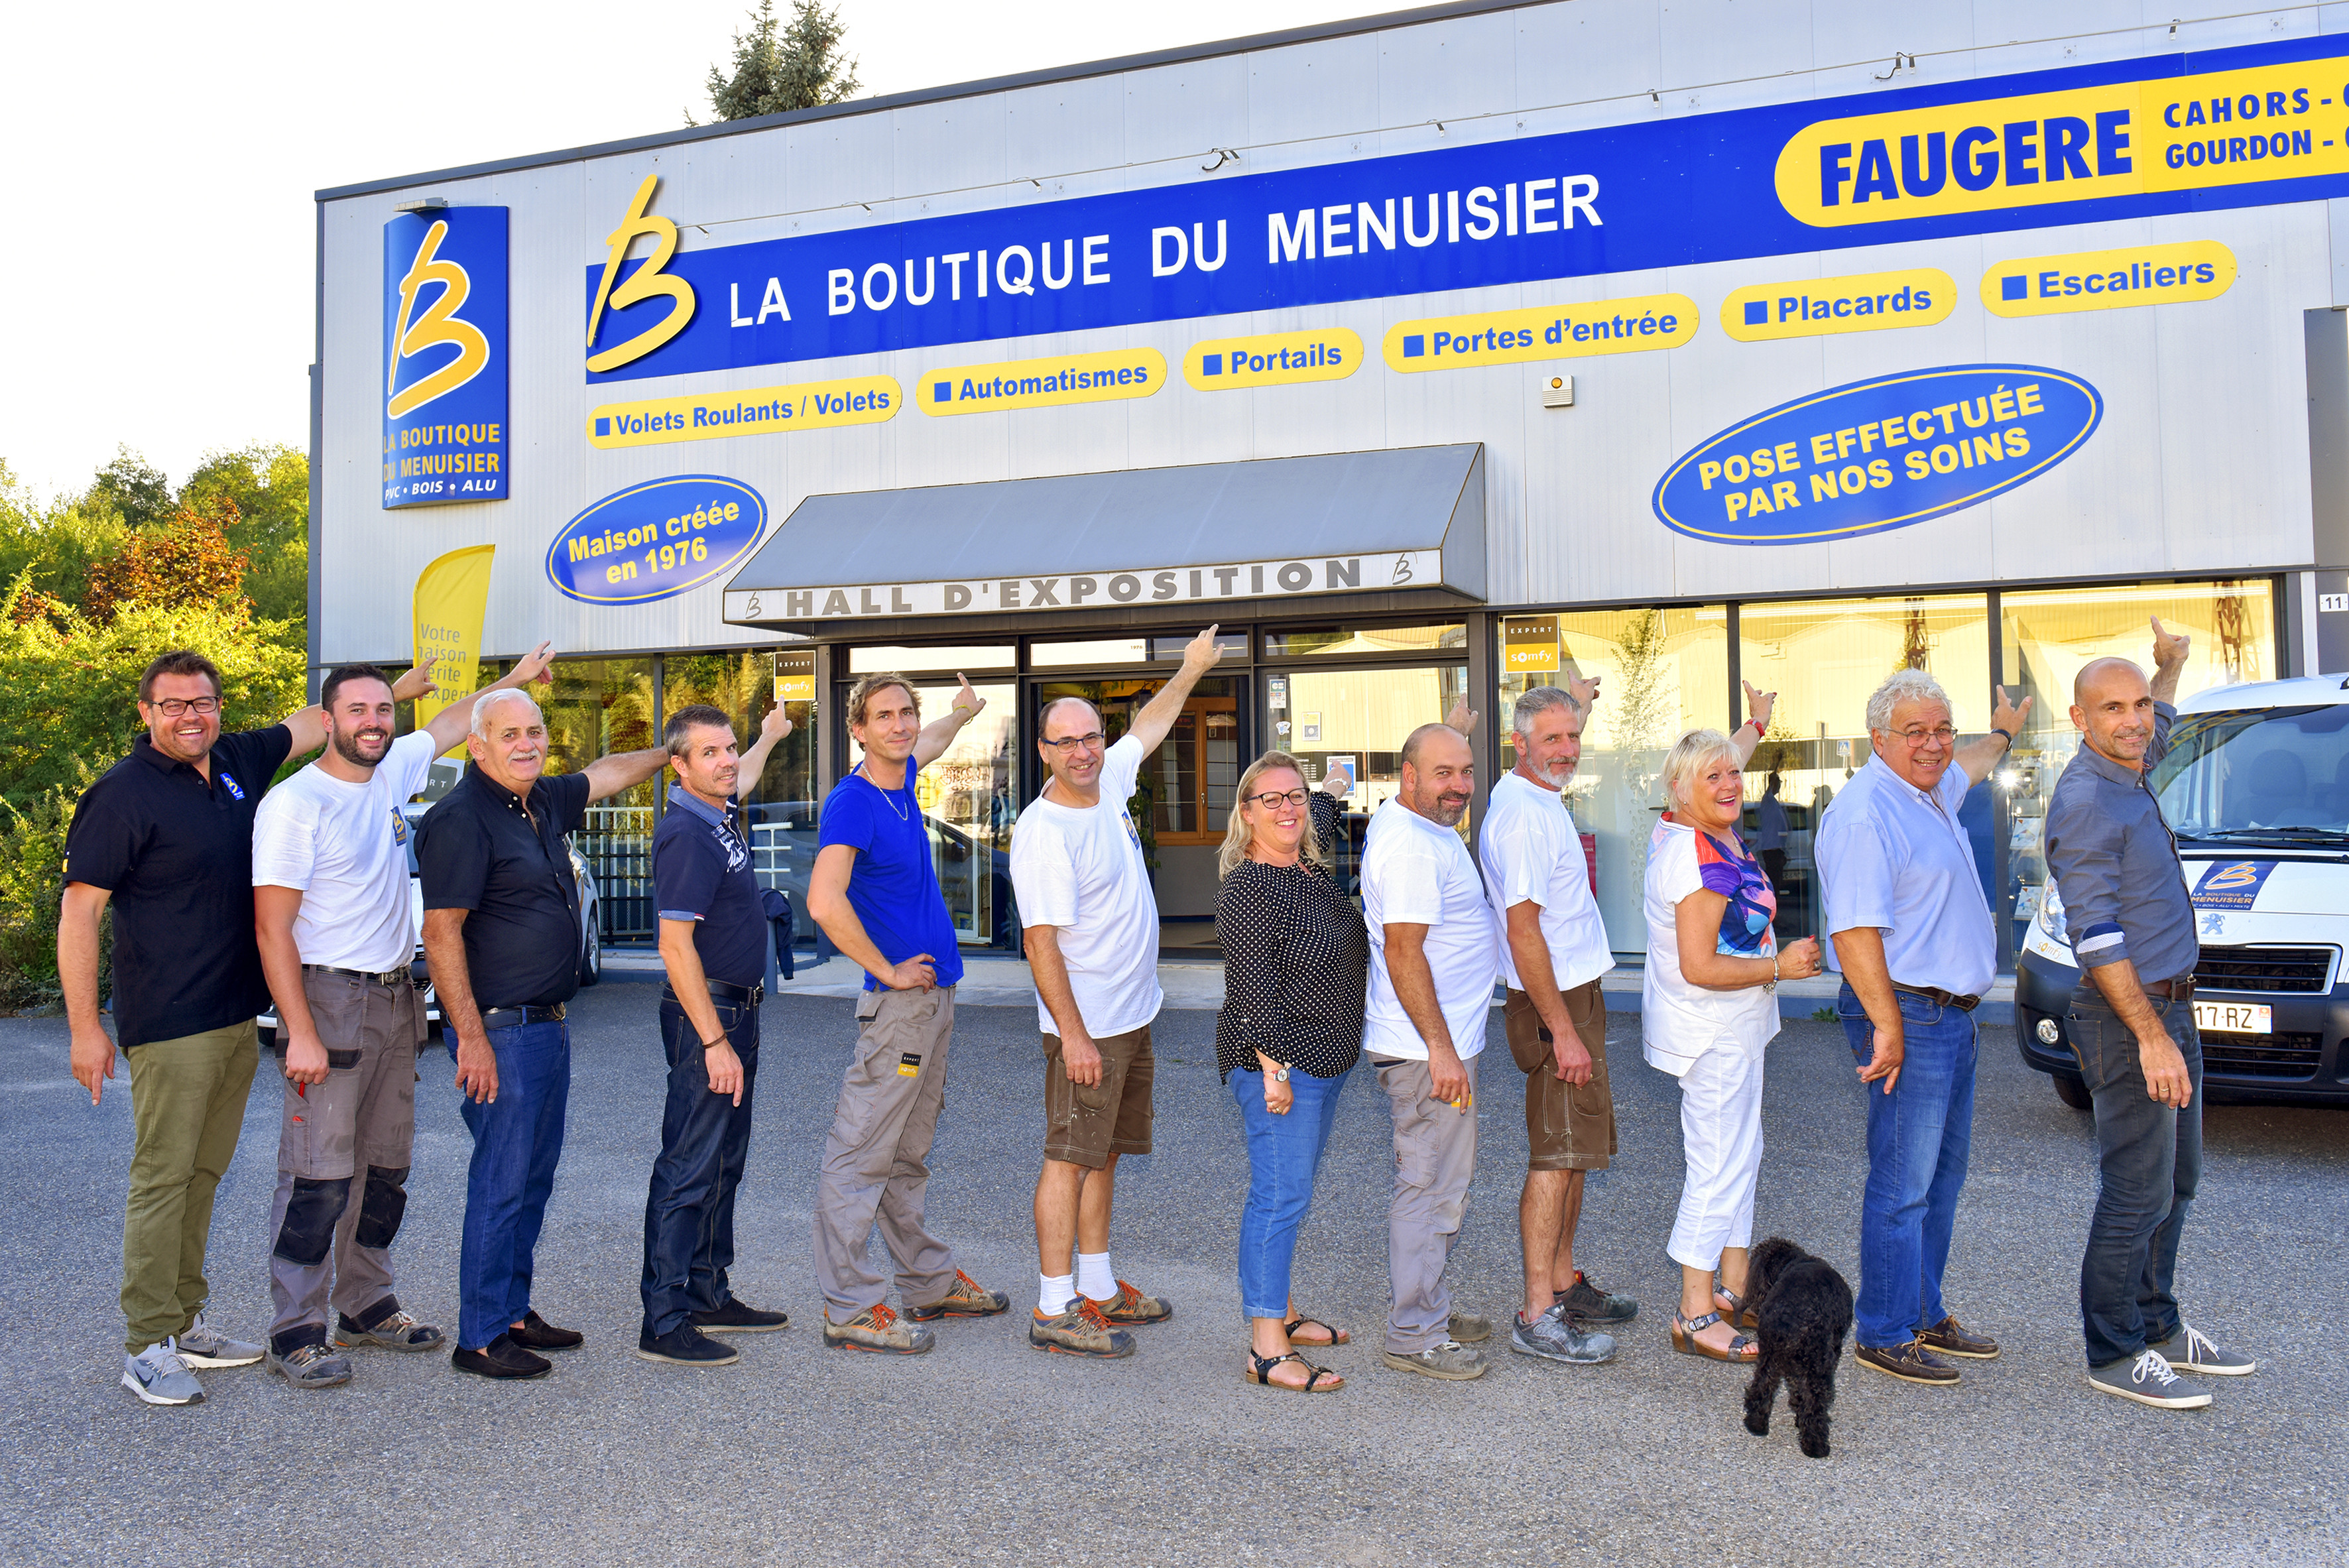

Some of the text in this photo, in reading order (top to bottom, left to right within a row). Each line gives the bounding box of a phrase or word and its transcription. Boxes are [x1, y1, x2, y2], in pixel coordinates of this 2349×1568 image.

[2164, 88, 2310, 128] CAHORS
[1819, 109, 2133, 207] FAUGERE
[2165, 129, 2312, 169] GOURDON
[730, 174, 1604, 328] LA BOUTIQUE DU MENUISIER
[2039, 263, 2216, 298] Escaliers
[1778, 286, 1933, 322] Placards
[1433, 310, 1678, 356] Portes d'entrée
[1231, 343, 1343, 374] Portails
[959, 363, 1148, 401] Automatismes
[615, 412, 686, 436] Volets
[692, 397, 794, 428] Roulants
[815, 389, 890, 416] Volets
[383, 424, 501, 453] LA BOUTIQUE
[1699, 384, 2045, 490] POSE EFFECTUÉE
[383, 453, 500, 482] DU MENUISIER
[1724, 428, 2031, 522] PAR NOS SOINS
[385, 479, 497, 501] PVC BOIS ALU
[568, 500, 740, 562] Maison créée
[606, 537, 708, 583] en 1976
[786, 587, 912, 618] HALL
[944, 558, 1361, 610] D'EXPOSITION
[2326, 597, 2342, 609] 11
[420, 623, 460, 643] Votre
[1510, 626, 1552, 634] EXPERT
[427, 663, 461, 682] érite
[1511, 650, 1551, 662] somfy
[423, 688, 469, 703] xpert
[779, 681, 810, 692] somfy
[2037, 941, 2063, 959] somfy
[2195, 1006, 2253, 1028] 17-RZ
